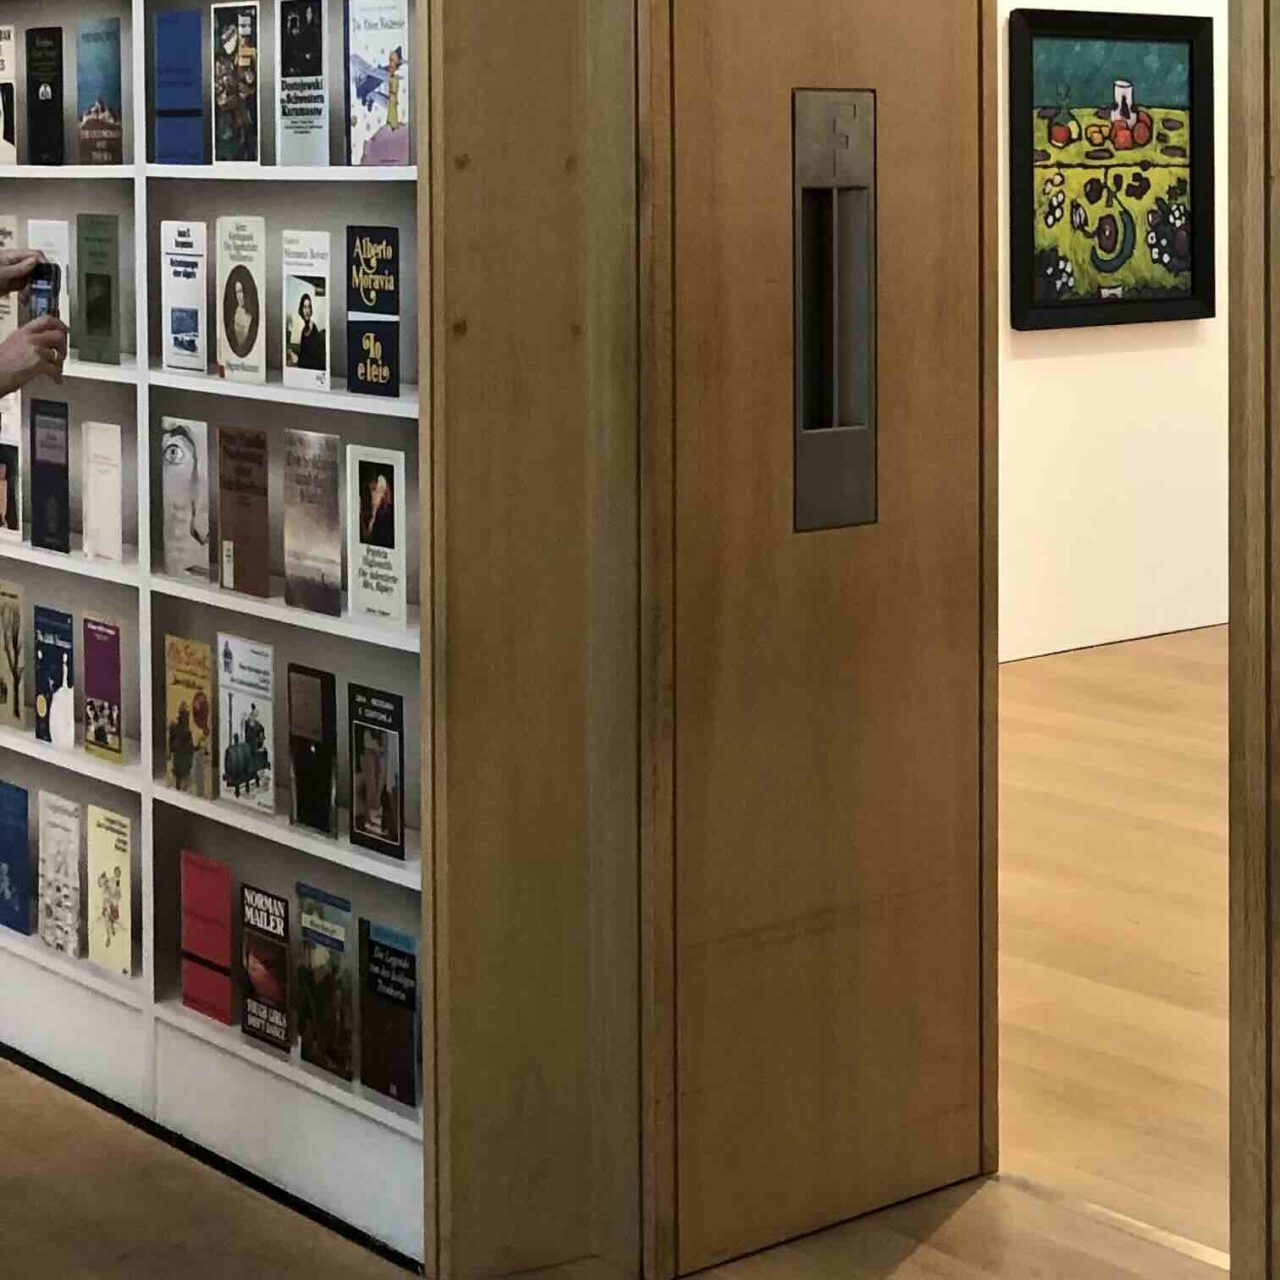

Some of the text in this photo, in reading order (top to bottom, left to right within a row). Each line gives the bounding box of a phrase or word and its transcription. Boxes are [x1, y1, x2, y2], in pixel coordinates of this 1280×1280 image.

[353, 236, 393, 268] Alberto
[352, 265, 395, 302] Moravia
[244, 887, 285, 917] NORMAN
[244, 907, 285, 937] MAILER
